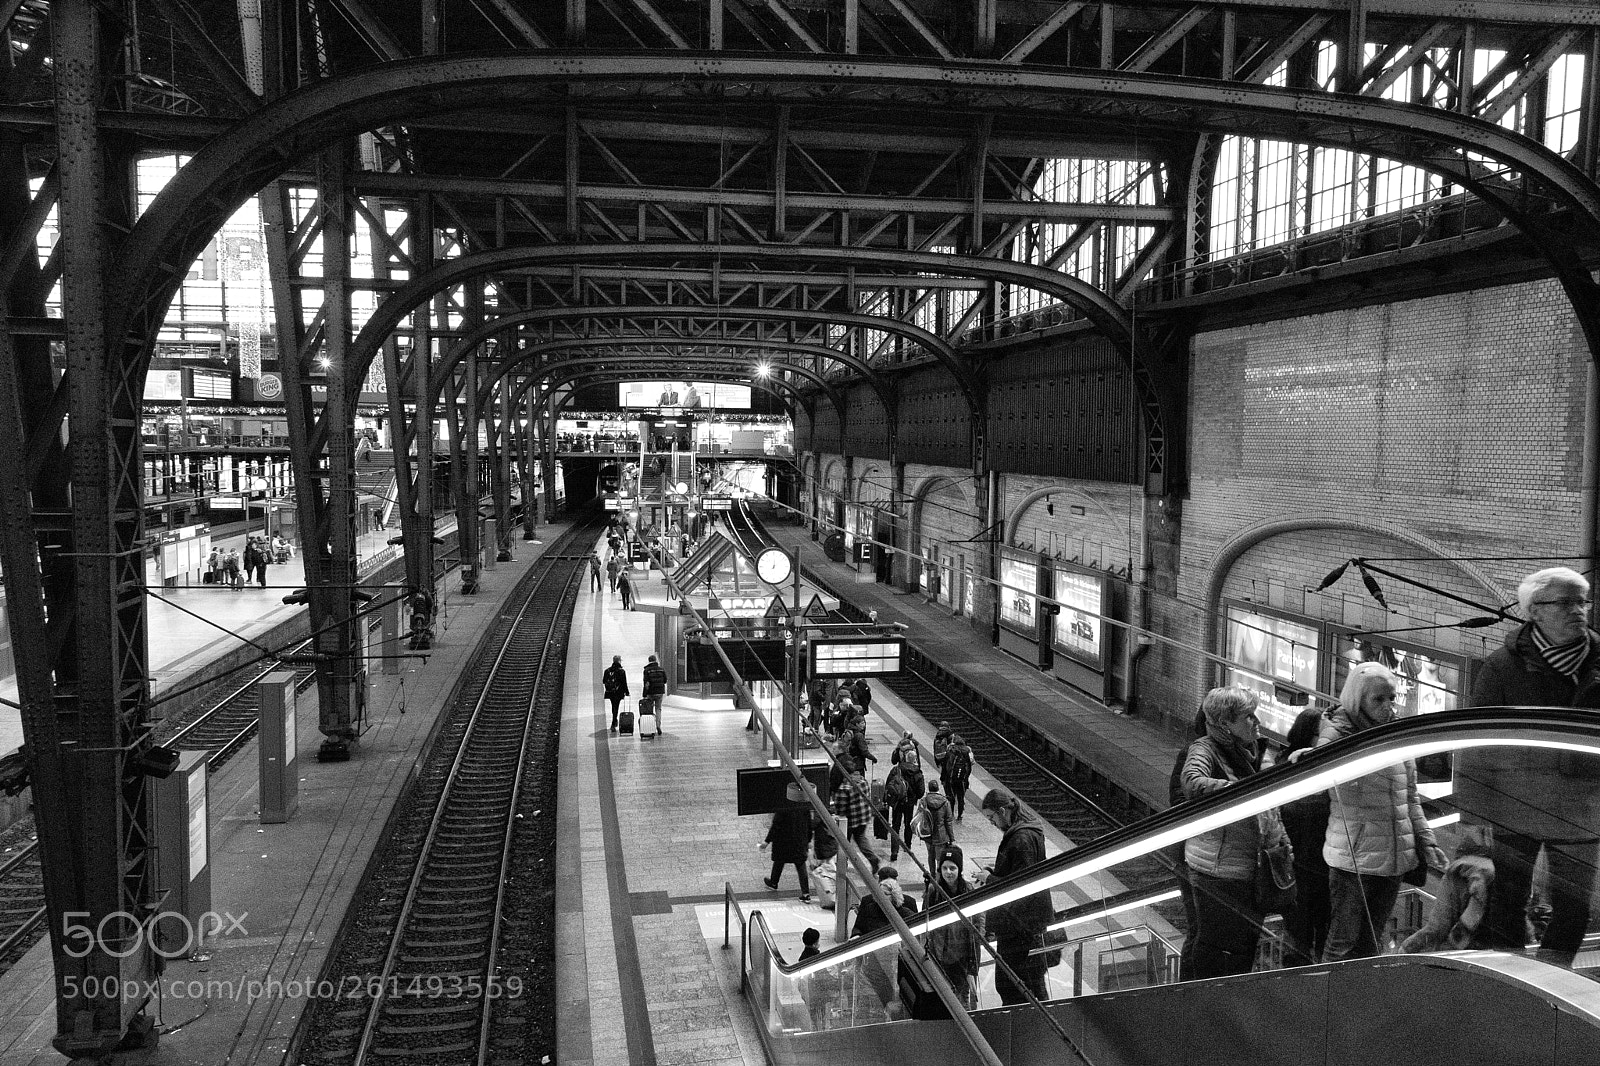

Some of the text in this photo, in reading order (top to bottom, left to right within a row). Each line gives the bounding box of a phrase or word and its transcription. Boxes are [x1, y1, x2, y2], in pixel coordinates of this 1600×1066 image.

[261, 382, 279, 393] KING
[361, 383, 387, 393] ING
[630, 543, 641, 558] E
[860, 543, 870, 559] E
[720, 598, 766, 609] SPAR
[1277, 648, 1306, 673] Parship
